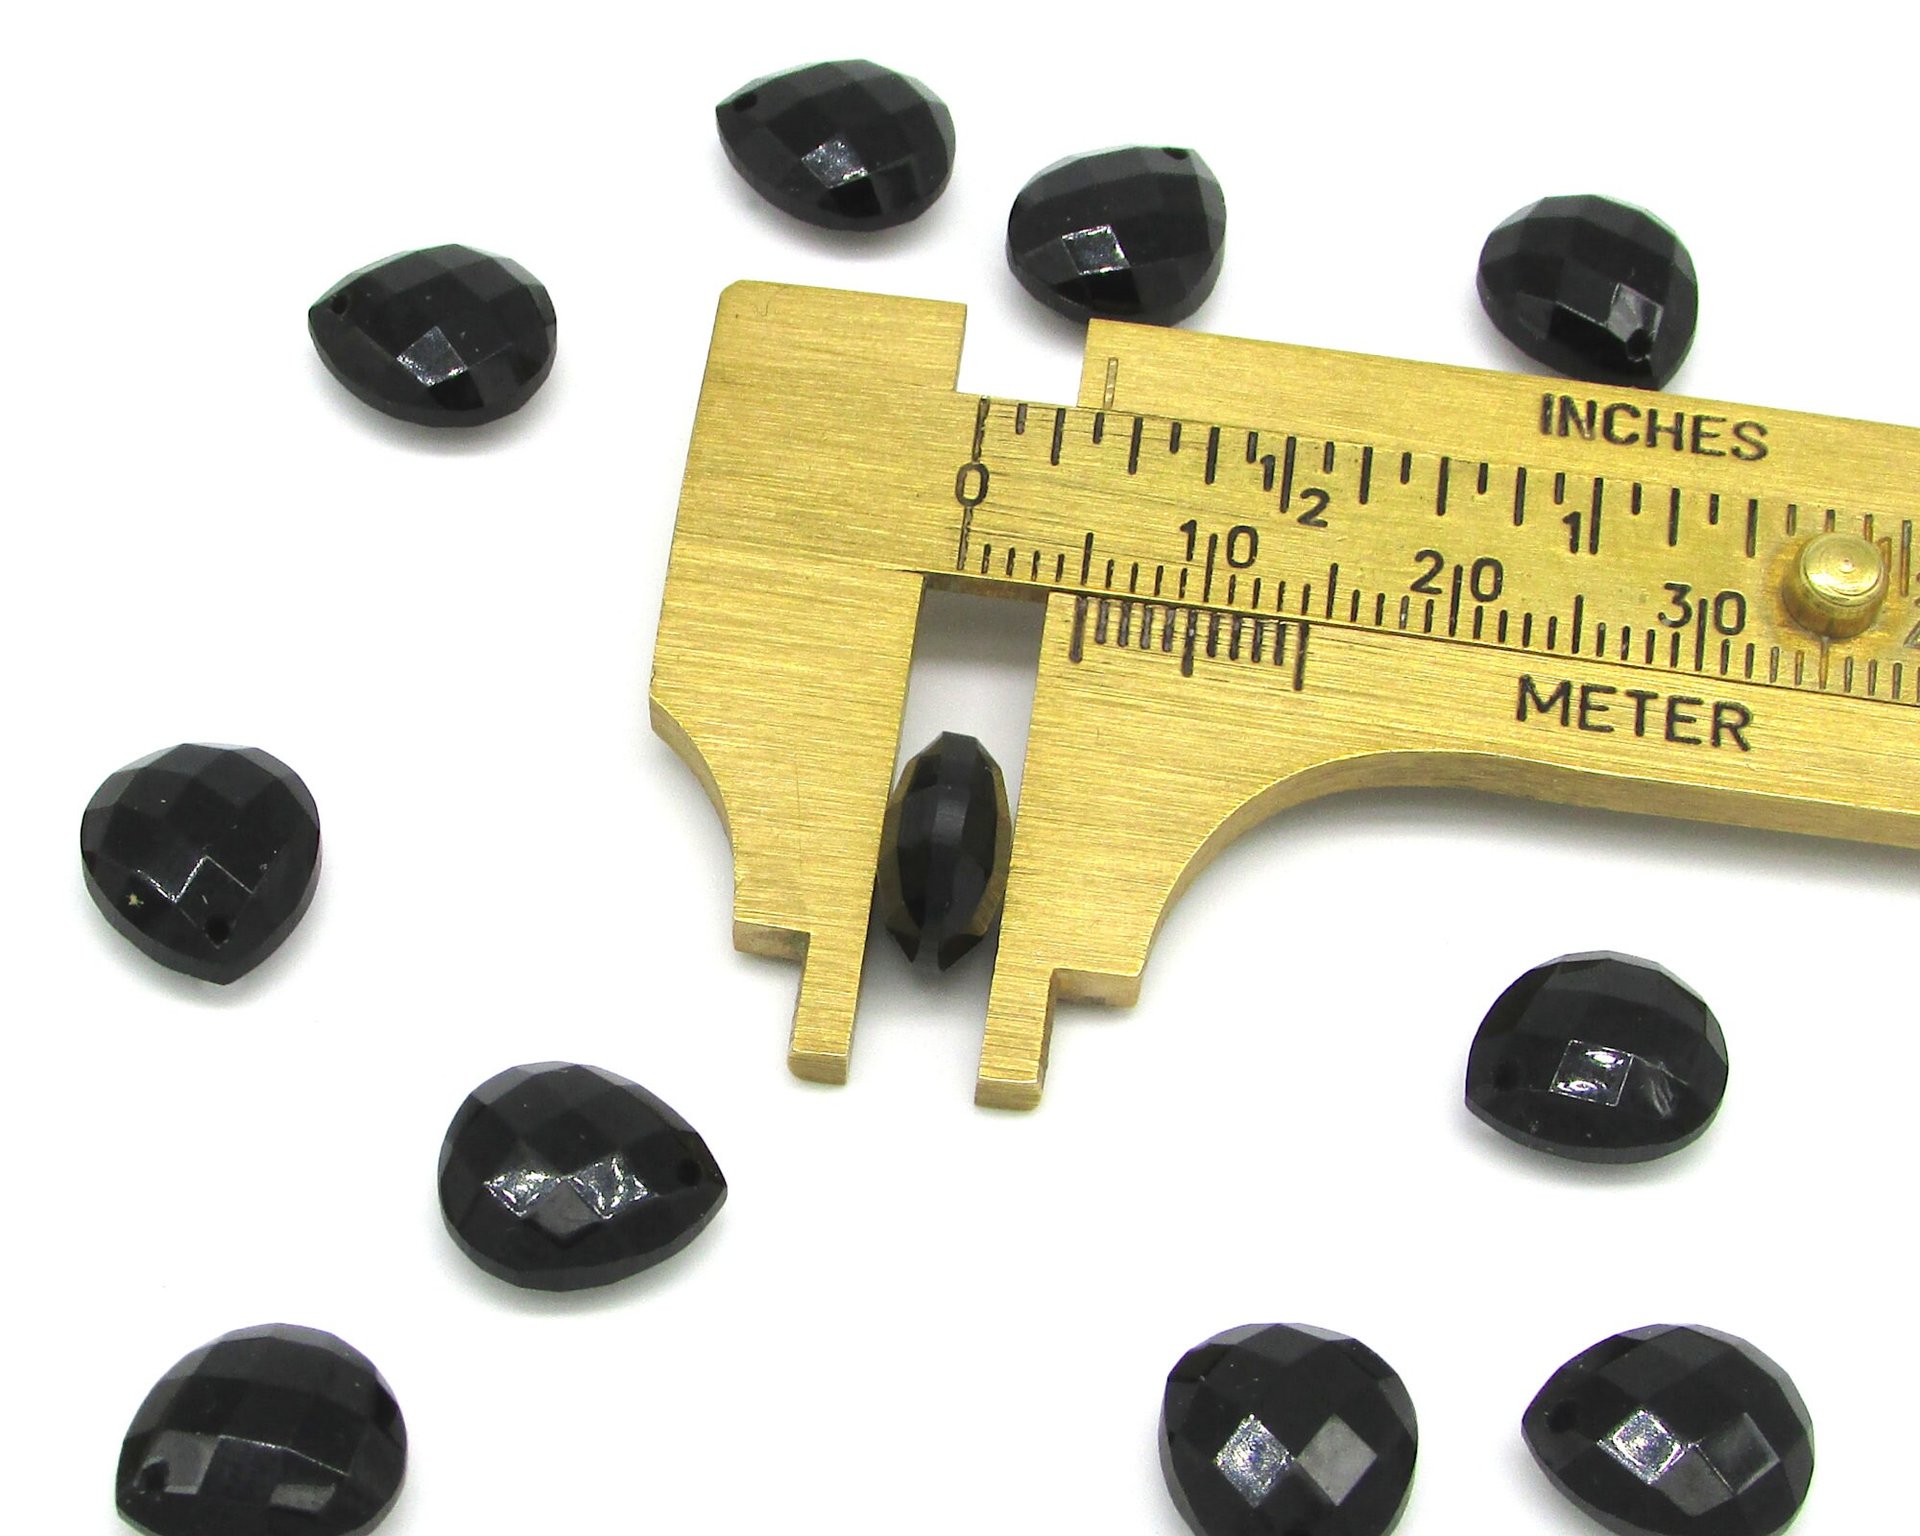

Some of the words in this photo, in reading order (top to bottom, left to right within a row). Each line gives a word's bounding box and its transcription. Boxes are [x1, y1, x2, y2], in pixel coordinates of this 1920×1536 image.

[1540, 393, 1769, 461] INCHES
[955, 461, 990, 507] 0
[1562, 511, 1582, 554] 1
[1516, 673, 1753, 752] METER
